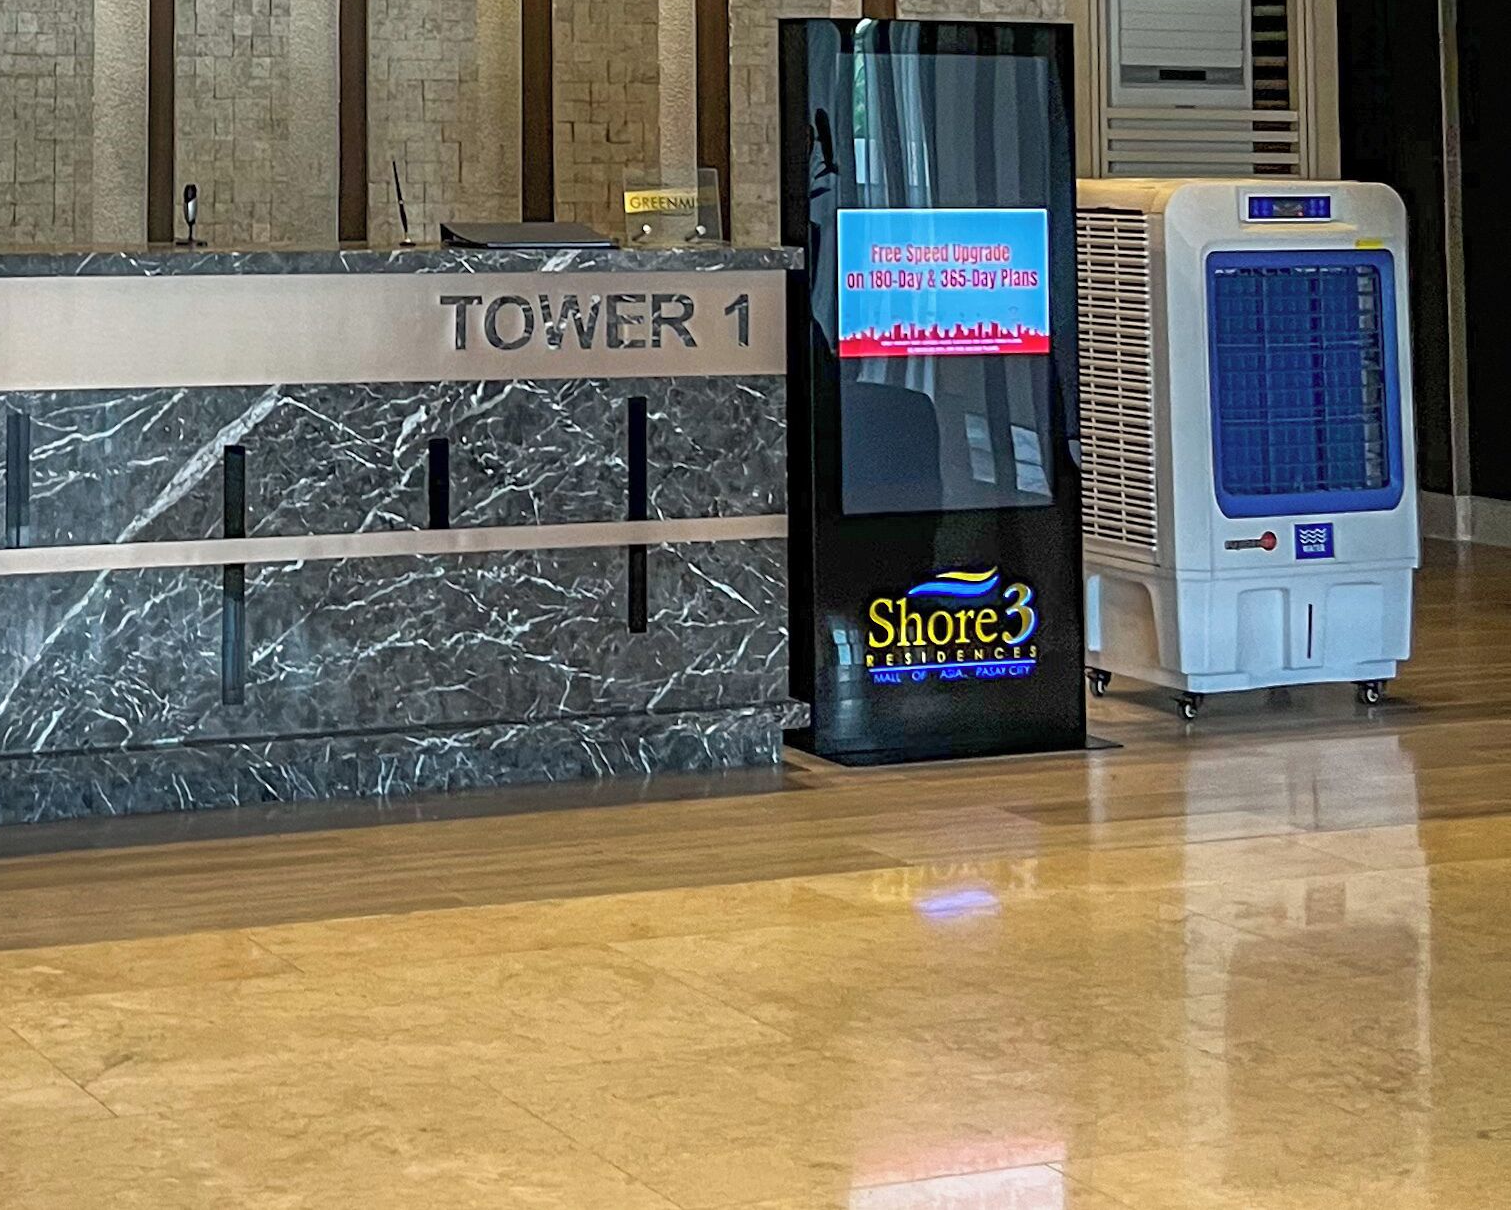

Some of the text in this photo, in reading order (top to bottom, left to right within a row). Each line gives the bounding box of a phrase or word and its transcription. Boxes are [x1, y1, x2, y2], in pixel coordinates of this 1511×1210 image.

[872, 243, 1010, 265] Free Speed Upgrade
[847, 268, 1038, 291] on 180-Day & 365-Day Plans
[440, 292, 750, 351] TOWER 1
[866, 645, 1037, 668] RESIDENCES
[874, 673, 902, 684] MALL
